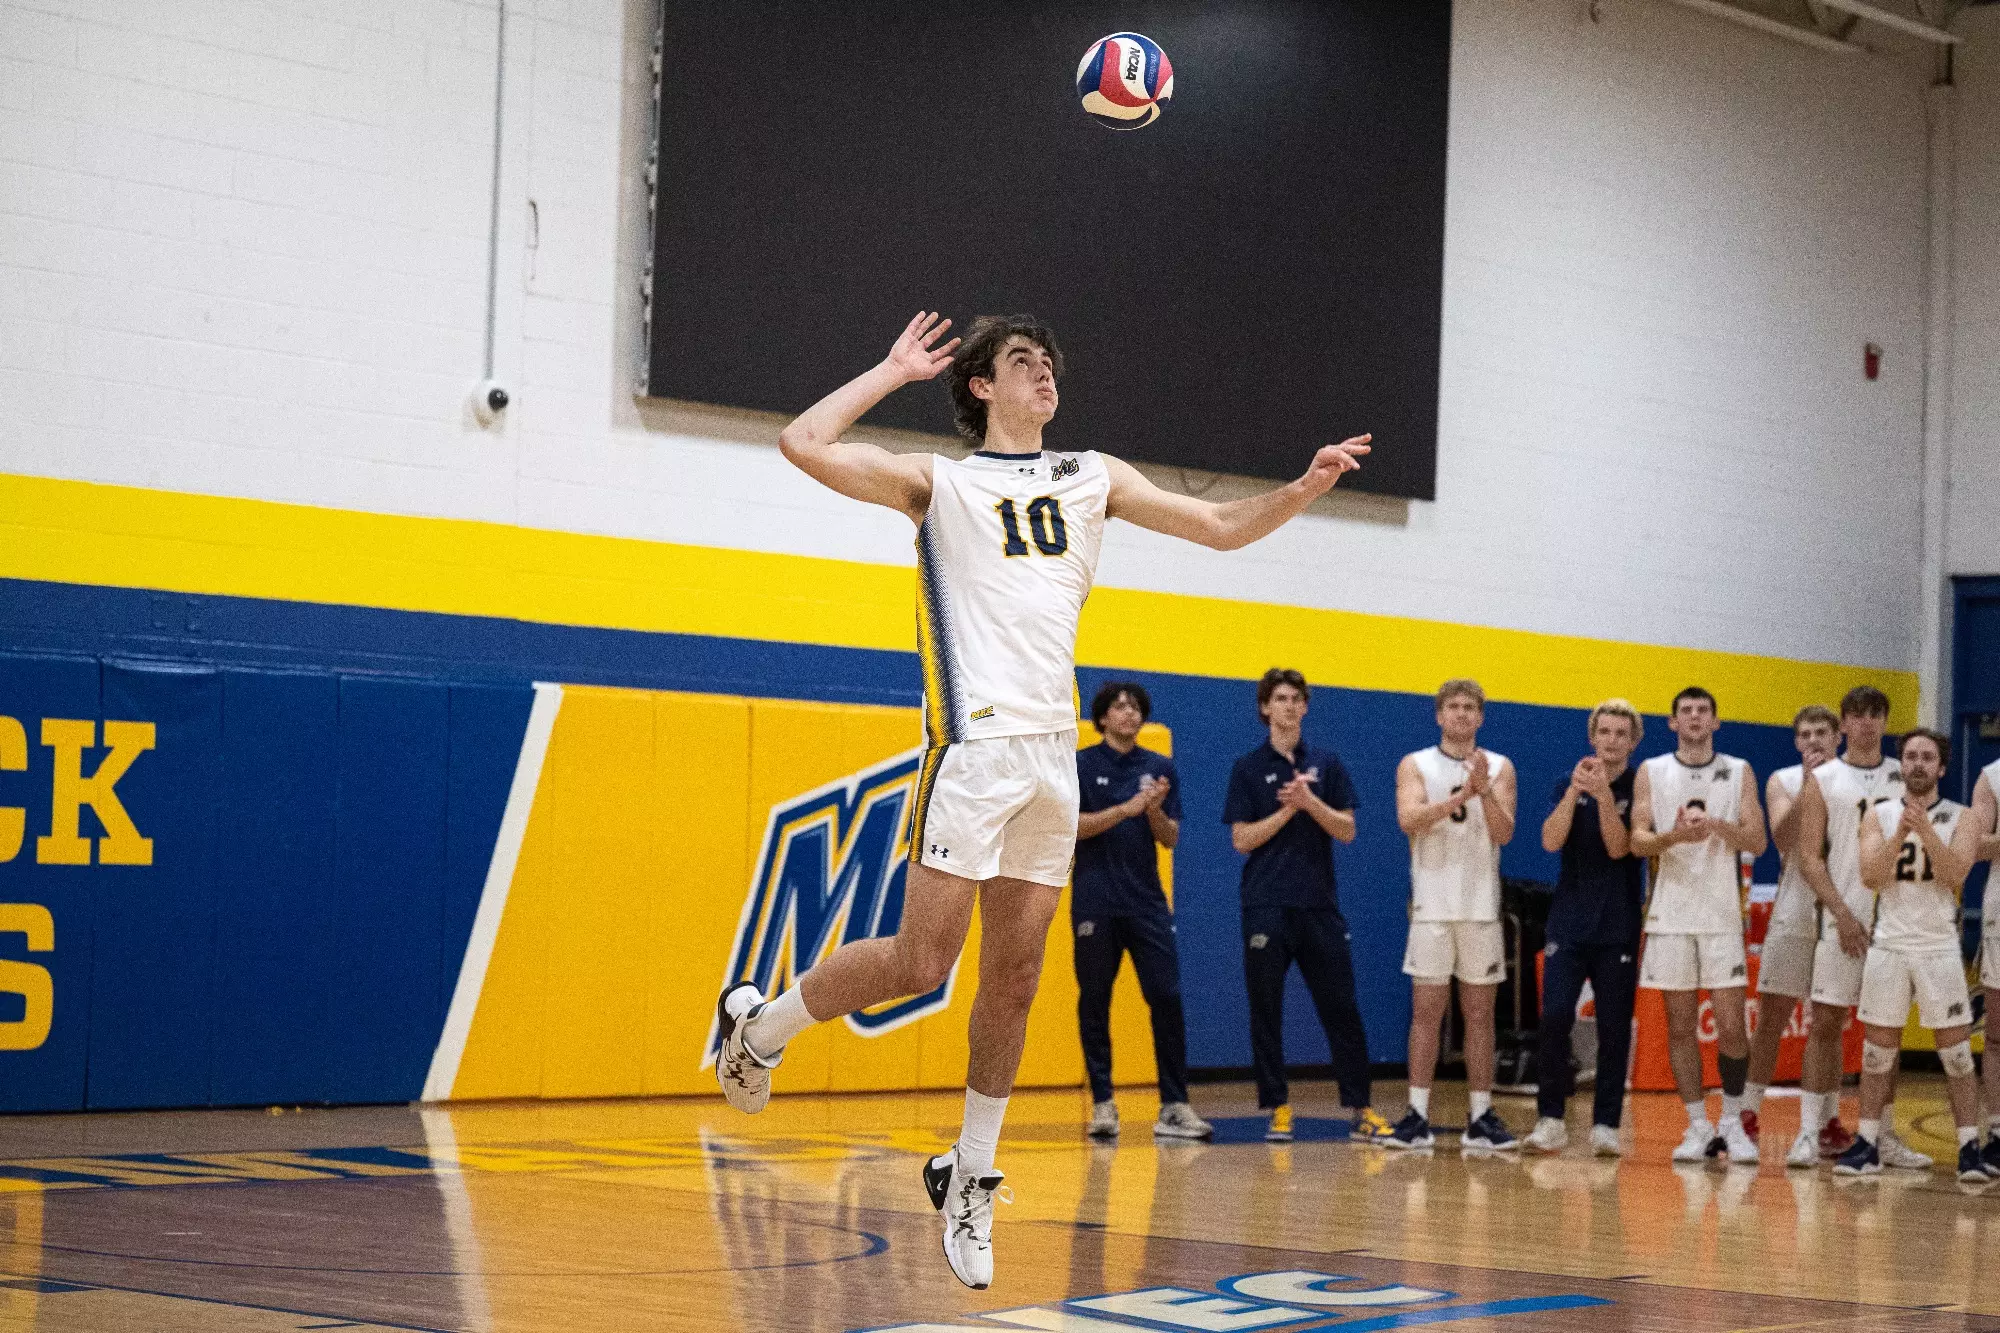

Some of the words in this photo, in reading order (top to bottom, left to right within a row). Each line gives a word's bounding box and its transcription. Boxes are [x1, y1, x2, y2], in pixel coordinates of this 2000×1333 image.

[1126, 47, 1140, 81] NCAA
[993, 495, 1069, 558] 10
[1896, 842, 1934, 881] 21
